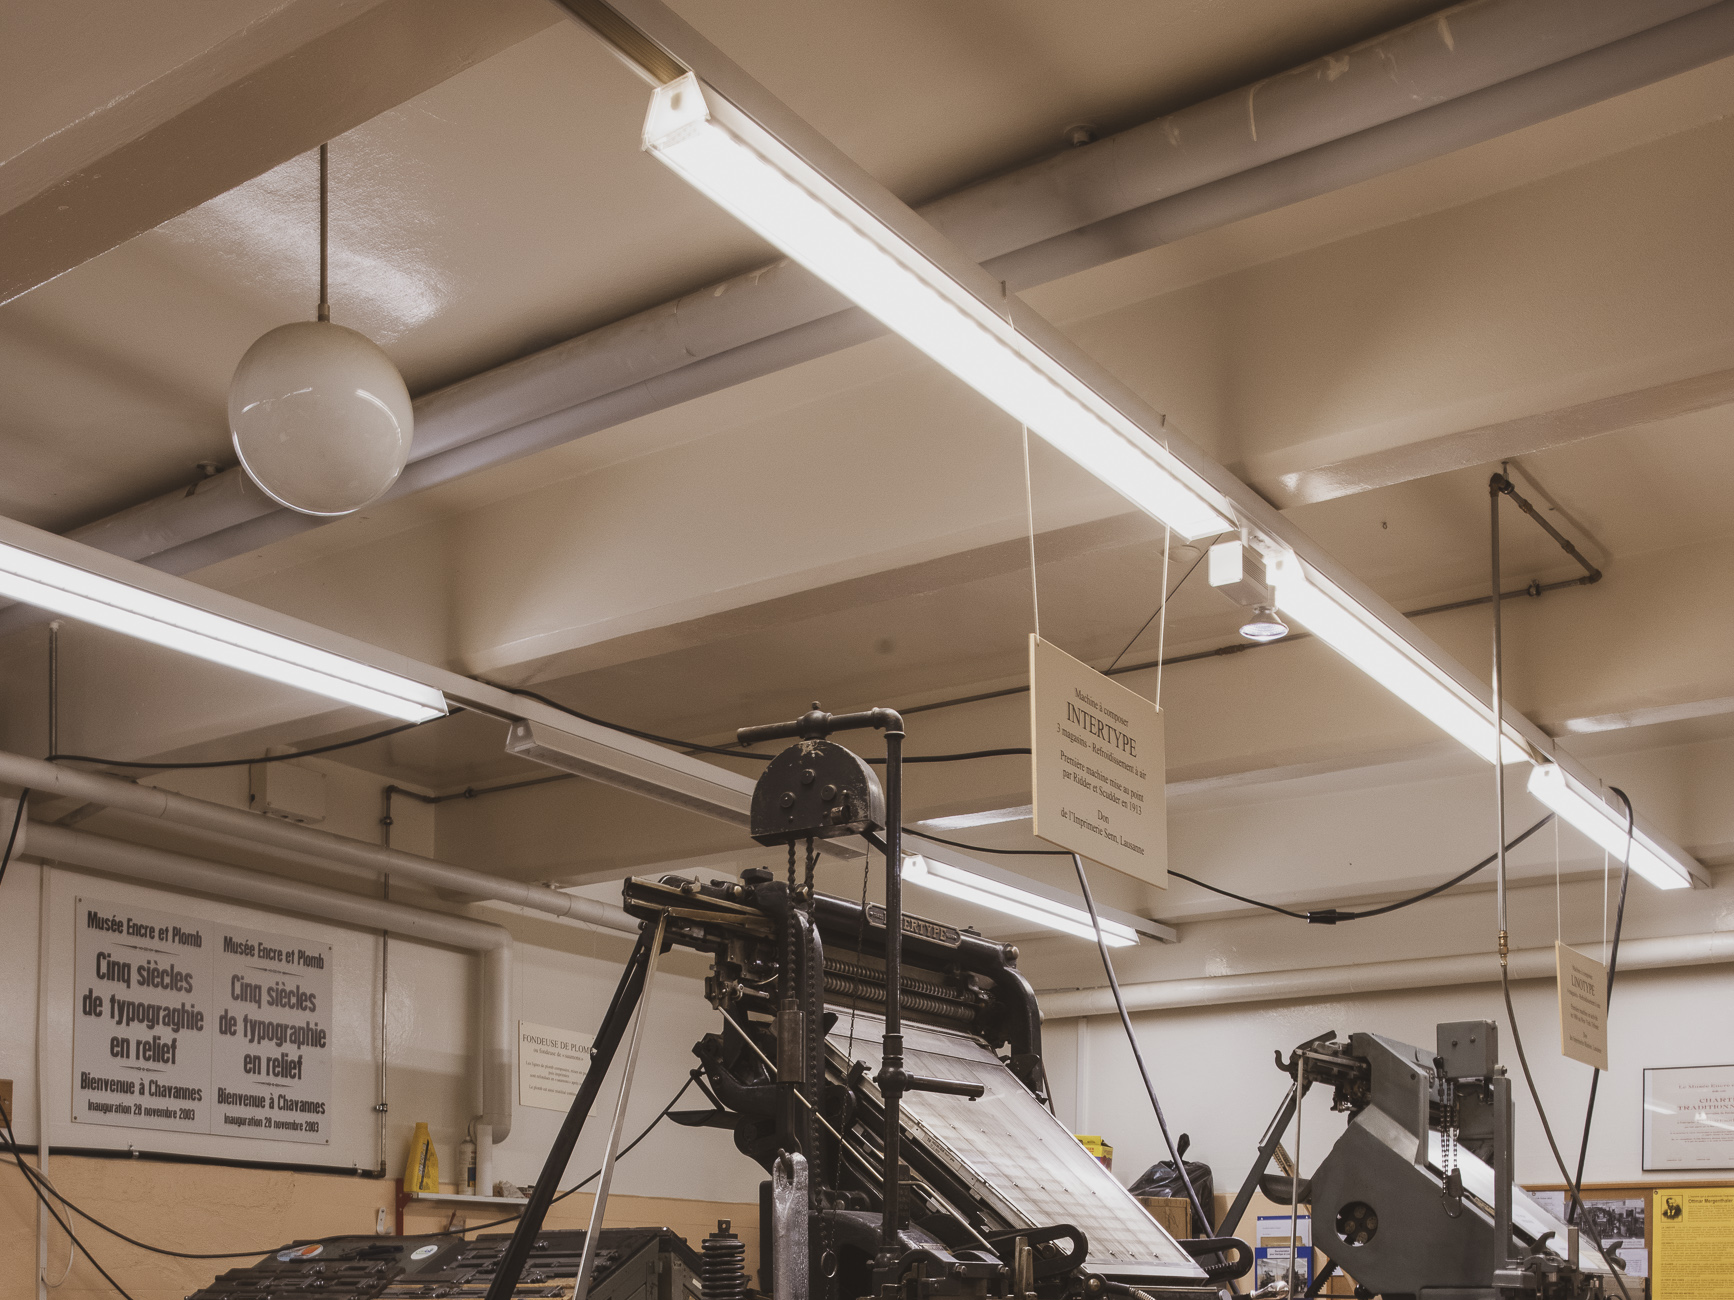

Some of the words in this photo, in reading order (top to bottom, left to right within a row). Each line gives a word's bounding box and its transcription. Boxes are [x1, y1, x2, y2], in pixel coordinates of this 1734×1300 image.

[1075, 688, 1098, 709] Machine
[1104, 708, 1129, 727] composer
[1066, 701, 1137, 758] INTERTYPE
[1057, 722, 1060, 732] 3
[1062, 728, 1088, 748] magasins
[1092, 742, 1134, 774] Refroidissement
[1060, 750, 1085, 772] Première
[1086, 766, 1108, 784] machine
[1110, 778, 1122, 792] mise
[1122, 786, 1130, 795] au
[1130, 790, 1144, 802] point
[1062, 769, 1072, 780] par
[1073, 772, 1092, 790] Ridder
[1092, 784, 1098, 794] et
[1098, 786, 1120, 805] Scudder
[1122, 800, 1128, 808] en
[1129, 802, 1142, 816] 1913
[1060, 807, 1068, 819] de
[1120, 834, 1145, 856] Lausanne
[1097, 809, 1110, 824] Don
[87, 910, 124, 935] Musée
[126, 918, 156, 940] Encre
[158, 925, 170, 942] et
[172, 927, 202, 948] Plomb
[224, 936, 256, 958] Musée
[258, 942, 283, 963] Encre
[286, 948, 296, 964] et
[298, 949, 324, 970] Plomb
[96, 951, 131, 989] Cinq
[136, 960, 194, 994] siècles
[82, 988, 104, 1018] de
[230, 974, 262, 1010] Cinq
[266, 980, 317, 1013] siècles
[218, 1008, 238, 1036] de
[242, 1013, 327, 1050] typographie
[522, 1034, 558, 1049] FONDEUSE
[560, 1041, 570, 1050] DE
[570, 1043, 590, 1055] PLOM
[110, 1034, 130, 1060] en
[136, 1034, 178, 1065] relief
[244, 1052, 262, 1076] en
[266, 1052, 303, 1080] relief
[80, 1071, 136, 1095] Bienvenue
[138, 1077, 145, 1096] à
[148, 1078, 202, 1102] Chavannes
[217, 1086, 266, 1110] Bienvenue
[268, 1092, 275, 1110] à
[278, 1094, 326, 1116] Chavannes
[88, 1098, 132, 1116] Inauguration
[133, 1103, 142, 1116] 28
[144, 1105, 178, 1120] novembre
[178, 1108, 196, 1120] 2003
[224, 1112, 262, 1129] Inauguration
[264, 1116, 272, 1129] 28
[274, 1118, 304, 1132] novembre
[304, 1120, 320, 1133] 2003
